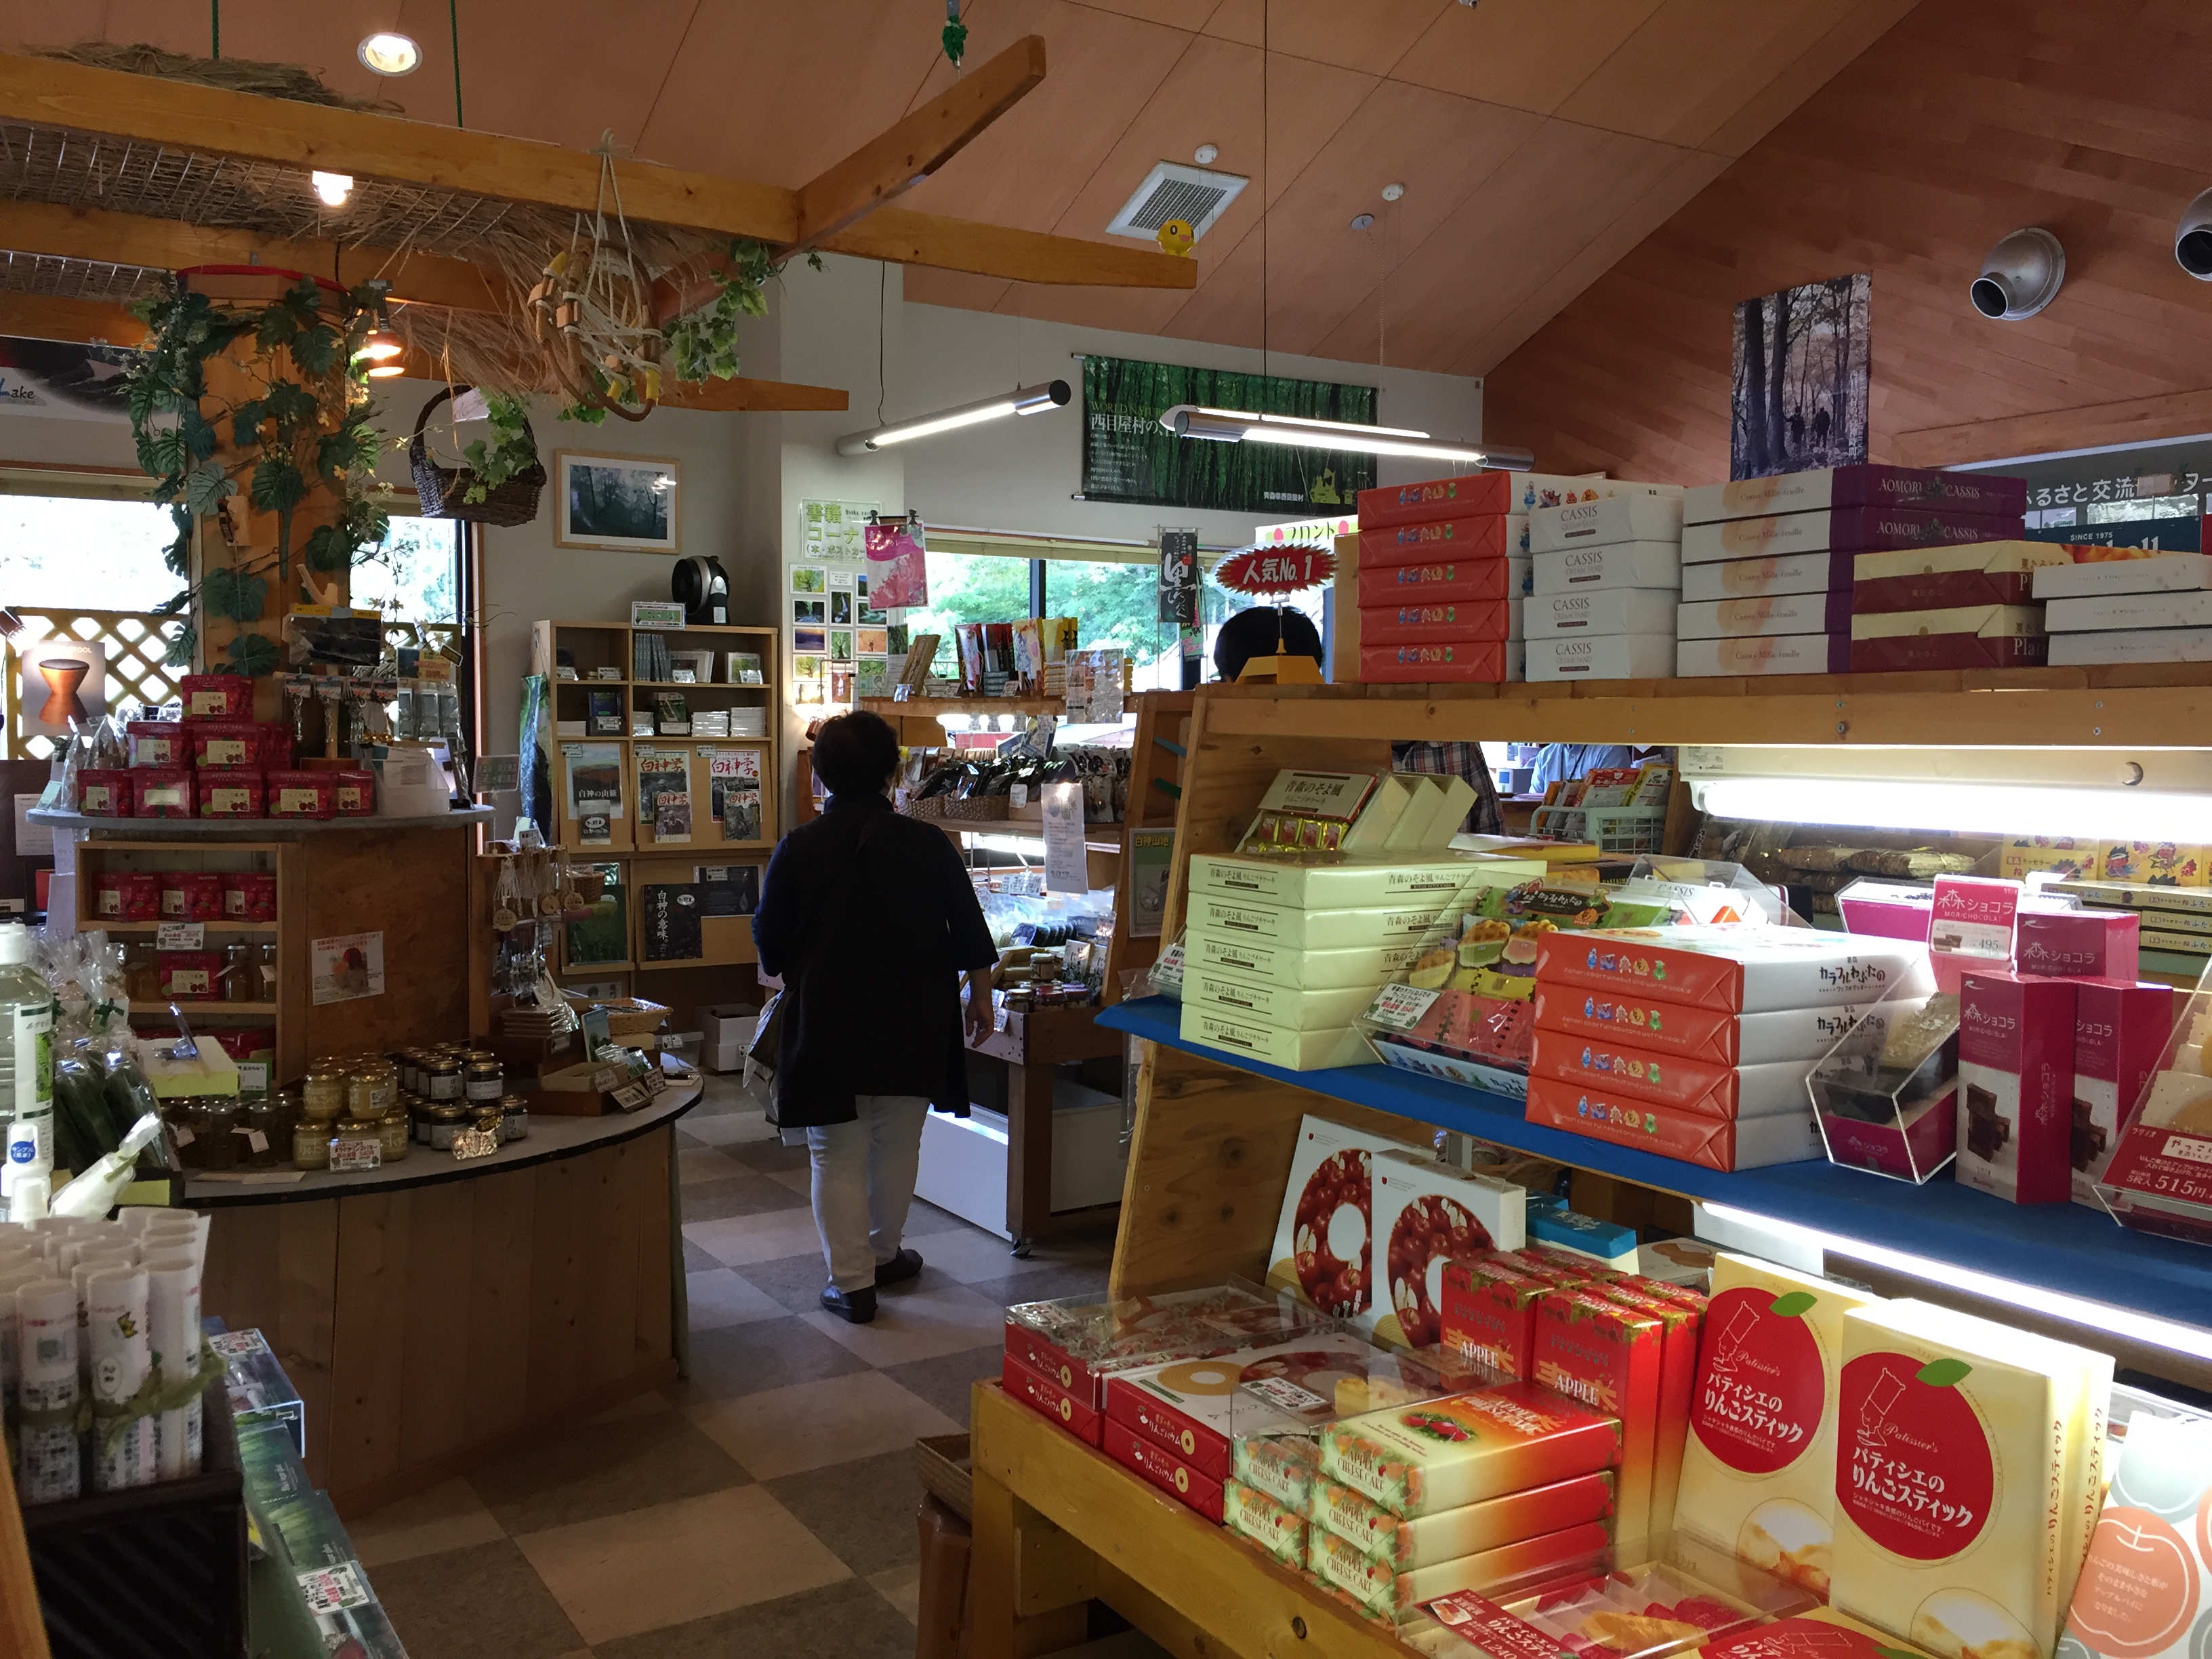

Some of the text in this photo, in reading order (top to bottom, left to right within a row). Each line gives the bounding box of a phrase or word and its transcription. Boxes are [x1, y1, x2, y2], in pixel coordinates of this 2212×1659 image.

[1091, 401, 1128, 413] WORLD
[1946, 483, 1979, 499] CASSIS
[2027, 472, 2212, 506] るさと交流ター
[806, 503, 842, 523] 書籍
[1561, 506, 1597, 522] CASSIS
[808, 527, 862, 544] コーナ
[1286, 522, 1335, 540] フロント
[1944, 525, 1978, 540] CASSIS
[2070, 532, 2113, 541] SINCE 1975
[1565, 552, 1603, 567] CASSIS
[1553, 598, 1590, 611] CASSIS
[1555, 642, 1591, 655] CASSIS
[640, 758, 684, 773] 白神学
[712, 758, 754, 775] 白神学
[1285, 779, 1344, 796] 青森のそよ風
[657, 793, 688, 806] 白神学
[1210, 868, 1242, 881] 青森のそよ風
[1388, 873, 1434, 884] 青森のそよ風
[1937, 889, 2013, 915] 森ショコラ
[657, 890, 670, 943] 白神の意味。
[1210, 908, 1242, 922] 青森のそよ風
[1387, 914, 1431, 927] 青森のそよ風
[1963, 913, 2002, 922] CHOCOLAT
[1206, 944, 1238, 958] 青森のそよ風
[1978, 939, 1999, 949] 495
[2024, 942, 2095, 964] 森ショコラ
[1820, 964, 1885, 985] カラフルねぶたの
[1204, 983, 1236, 996] 青森のそよ風
[1964, 1002, 2015, 1030] 森ショコラ
[1203, 1021, 1235, 1036] 青森のそよ風
[2034, 1063, 2051, 1126] 森ショコラ
[1460, 1340, 1498, 1368] APPLE
[1736, 1350, 1781, 1376] Patissier's
[1554, 1374, 1599, 1406] APPLE
[1707, 1372, 1782, 1412] パティシエの
[1704, 1389, 1803, 1443] りんごスティック
[1883, 1423, 1938, 1453] Patissier's
[1349, 1450, 1374, 1471] APPLE
[1853, 1447, 1945, 1493] パティシエの
[1337, 1457, 1384, 1492] CHEESE CAKE
[1852, 1464, 1973, 1528] りんごスティック
[1249, 1501, 1271, 1523] APPLE
[1340, 1500, 1365, 1523] APPLE
[2047, 1420, 2063, 1596] パティシエのりんごスティック
[1240, 1509, 1280, 1542] CHEESE CAKE
[1329, 1509, 1374, 1544] CHEESE CAKE
[1337, 1551, 1363, 1574] APPLE
[1327, 1557, 1373, 1594] CHEESE CAKE
